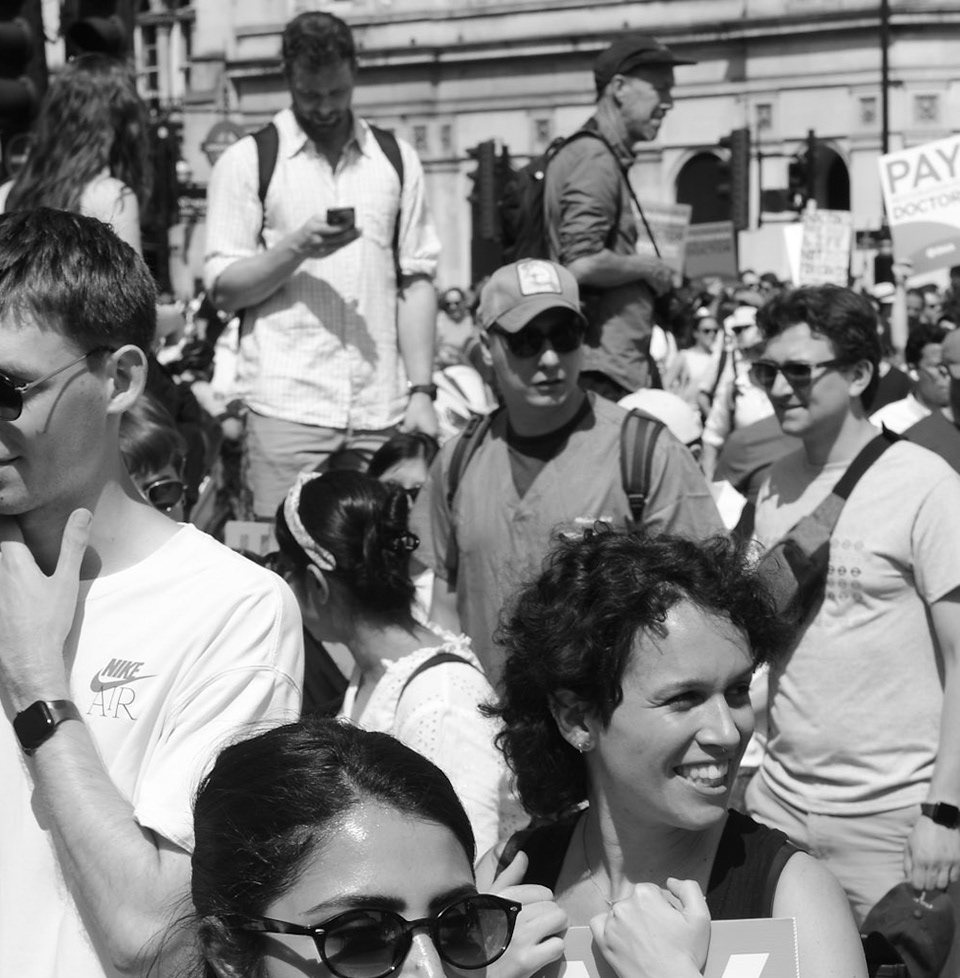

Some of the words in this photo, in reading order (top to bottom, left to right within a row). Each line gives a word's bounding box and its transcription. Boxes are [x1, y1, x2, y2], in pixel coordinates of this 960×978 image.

[886, 144, 960, 194] PAY
[101, 658, 145, 680] NIKE
[86, 685, 138, 721] AIR
